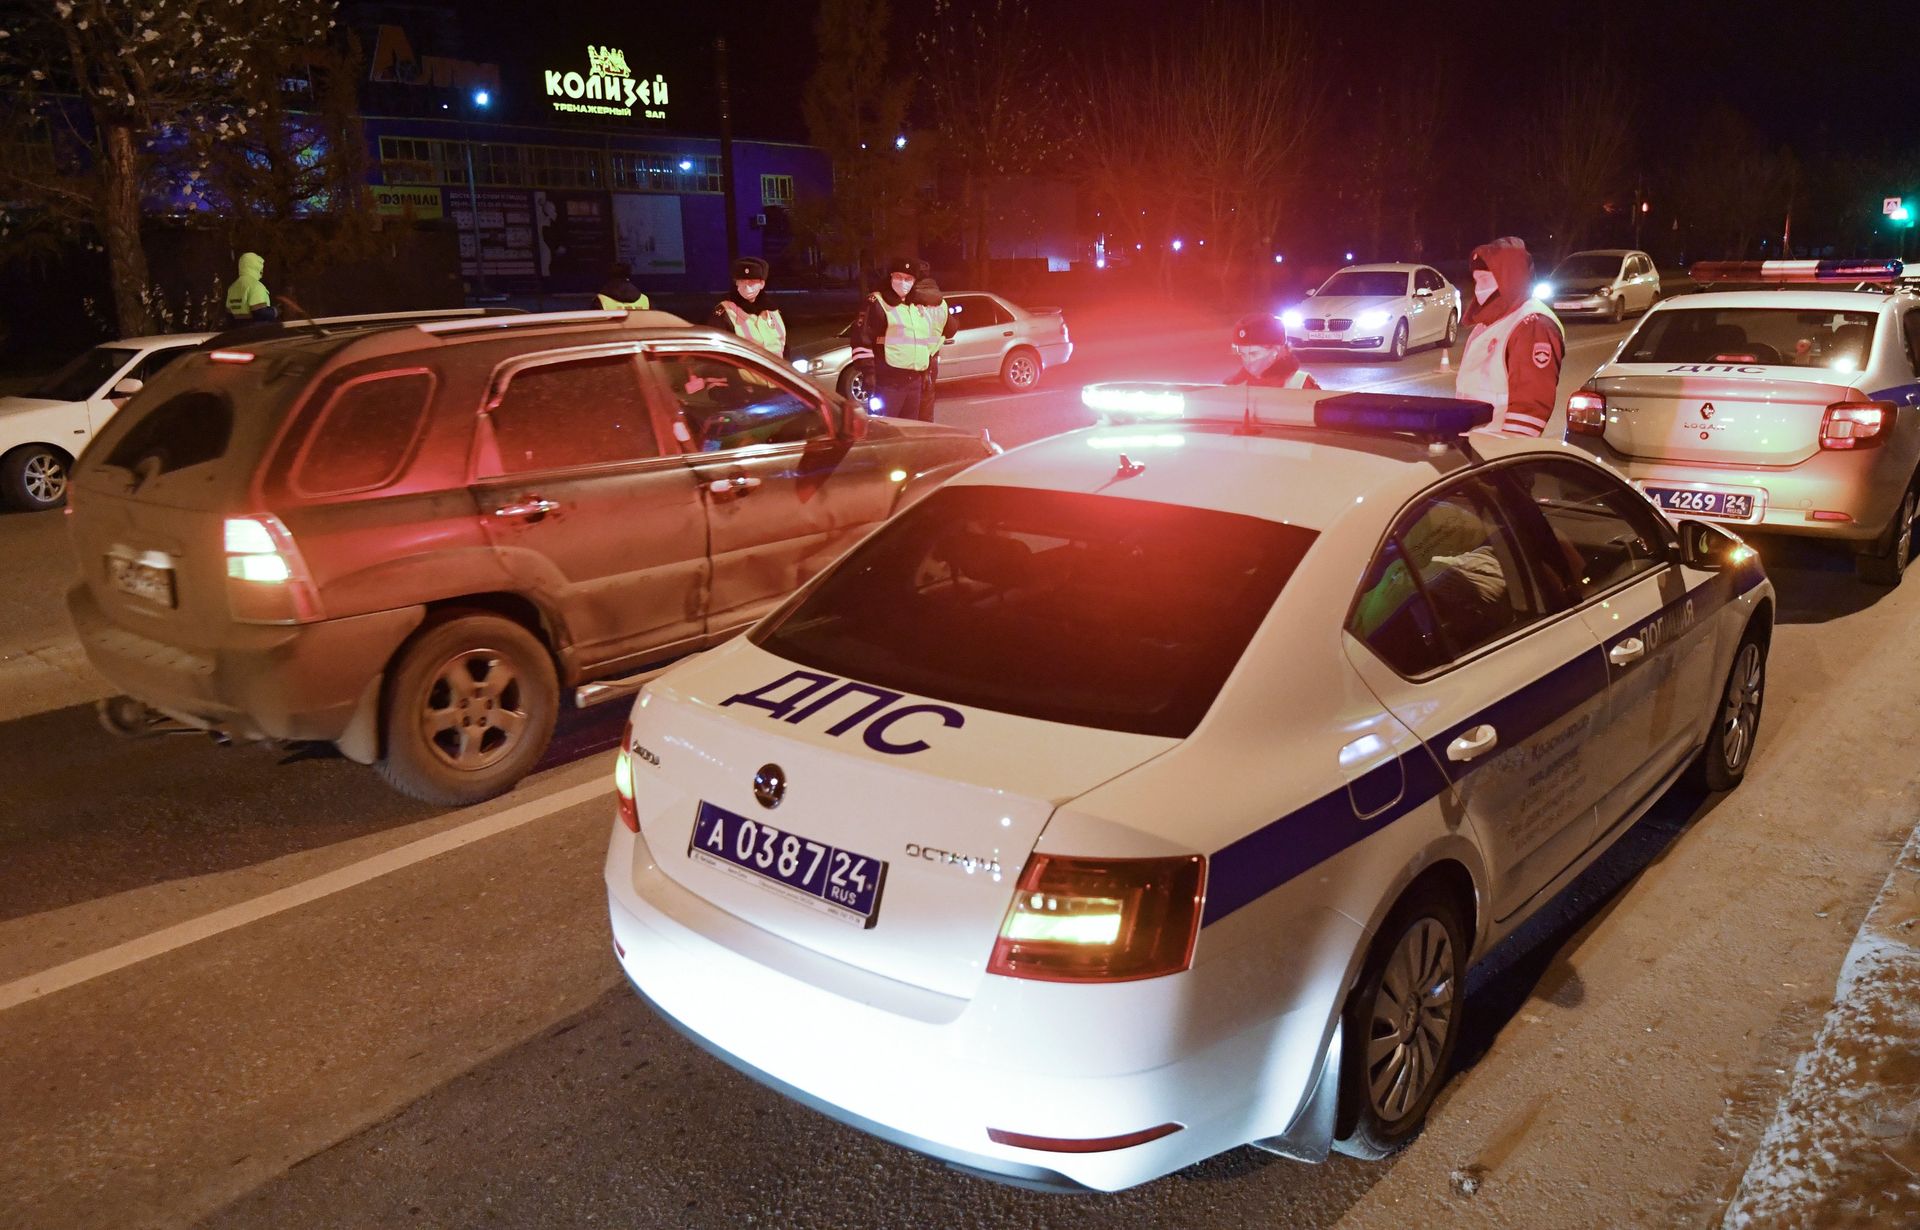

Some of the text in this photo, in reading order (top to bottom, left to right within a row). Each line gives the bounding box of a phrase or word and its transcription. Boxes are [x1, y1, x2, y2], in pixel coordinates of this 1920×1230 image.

[545, 70, 669, 107] КОЛИЗЕЙ
[553, 102, 666, 119] ТРЕНАЖЕРНЫЙ ЗАЛ
[1667, 365, 1766, 374] ДПС
[1669, 491, 1716, 511] 4269
[1726, 495, 1746, 511] 24
[718, 669, 965, 755] ДПС
[736, 820, 827, 886] 0387
[830, 852, 867, 893] 24
[831, 886, 857, 906] RUS
